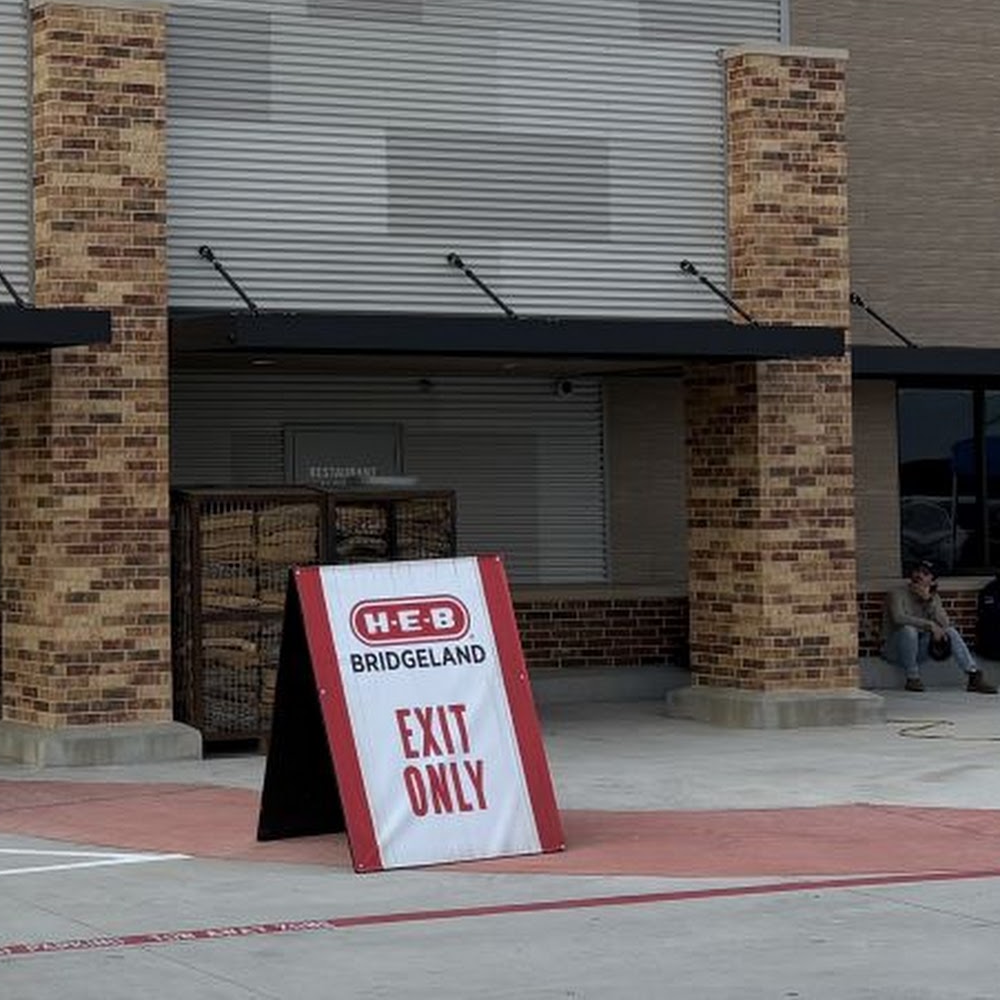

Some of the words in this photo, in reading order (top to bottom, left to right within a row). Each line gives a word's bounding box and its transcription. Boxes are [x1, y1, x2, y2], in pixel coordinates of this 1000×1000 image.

[350, 644, 487, 673] BRIDGELAND
[395, 704, 471, 759] EXIT
[403, 760, 488, 817] ONLY
